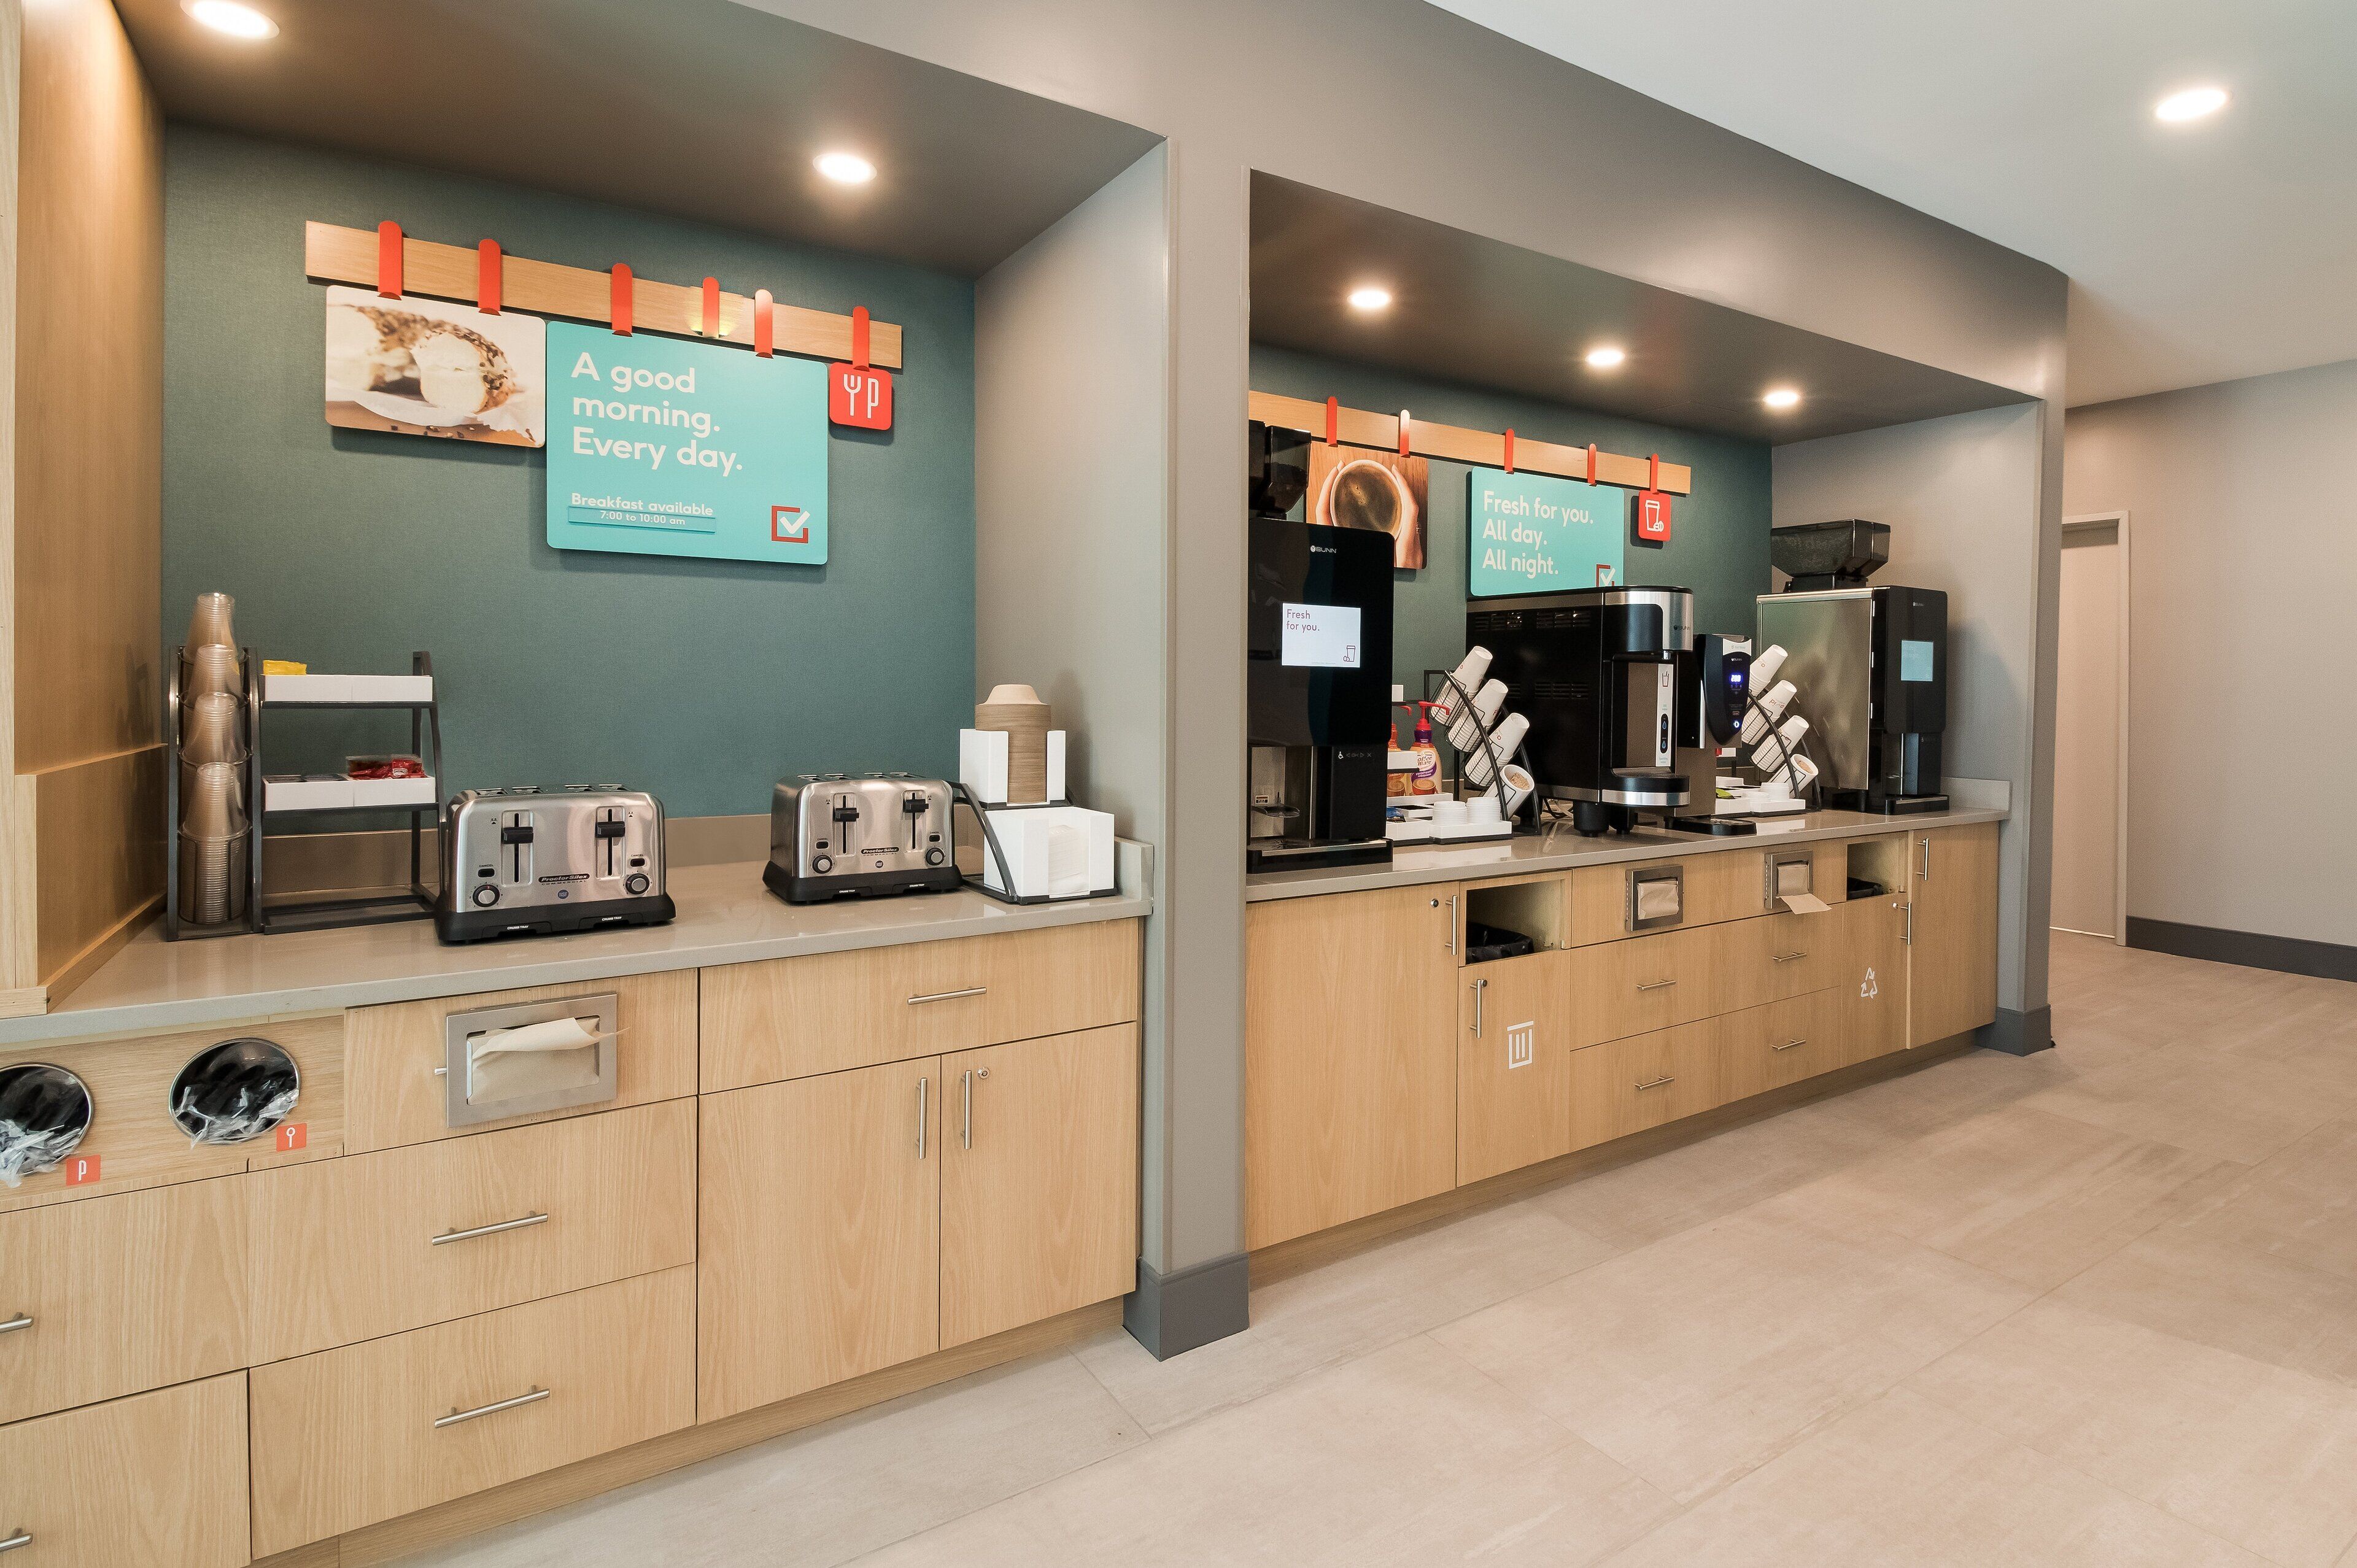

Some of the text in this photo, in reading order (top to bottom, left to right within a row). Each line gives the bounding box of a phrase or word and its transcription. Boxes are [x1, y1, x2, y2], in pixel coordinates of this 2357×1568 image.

[571, 352, 695, 393] A good
[573, 396, 720, 438] morning.
[573, 426, 743, 477] Every day.
[571, 492, 714, 516] Breakfast available
[600, 511, 623, 520] 7:00
[625, 513, 637, 522] to
[639, 514, 667, 524] 10:00
[1484, 490, 1593, 527] Fresh for you.
[1482, 519, 1547, 550] All day.
[1482, 548, 1558, 579] All night.
[1286, 620, 1320, 633] for you.
[1287, 609, 1310, 619] Fresh
